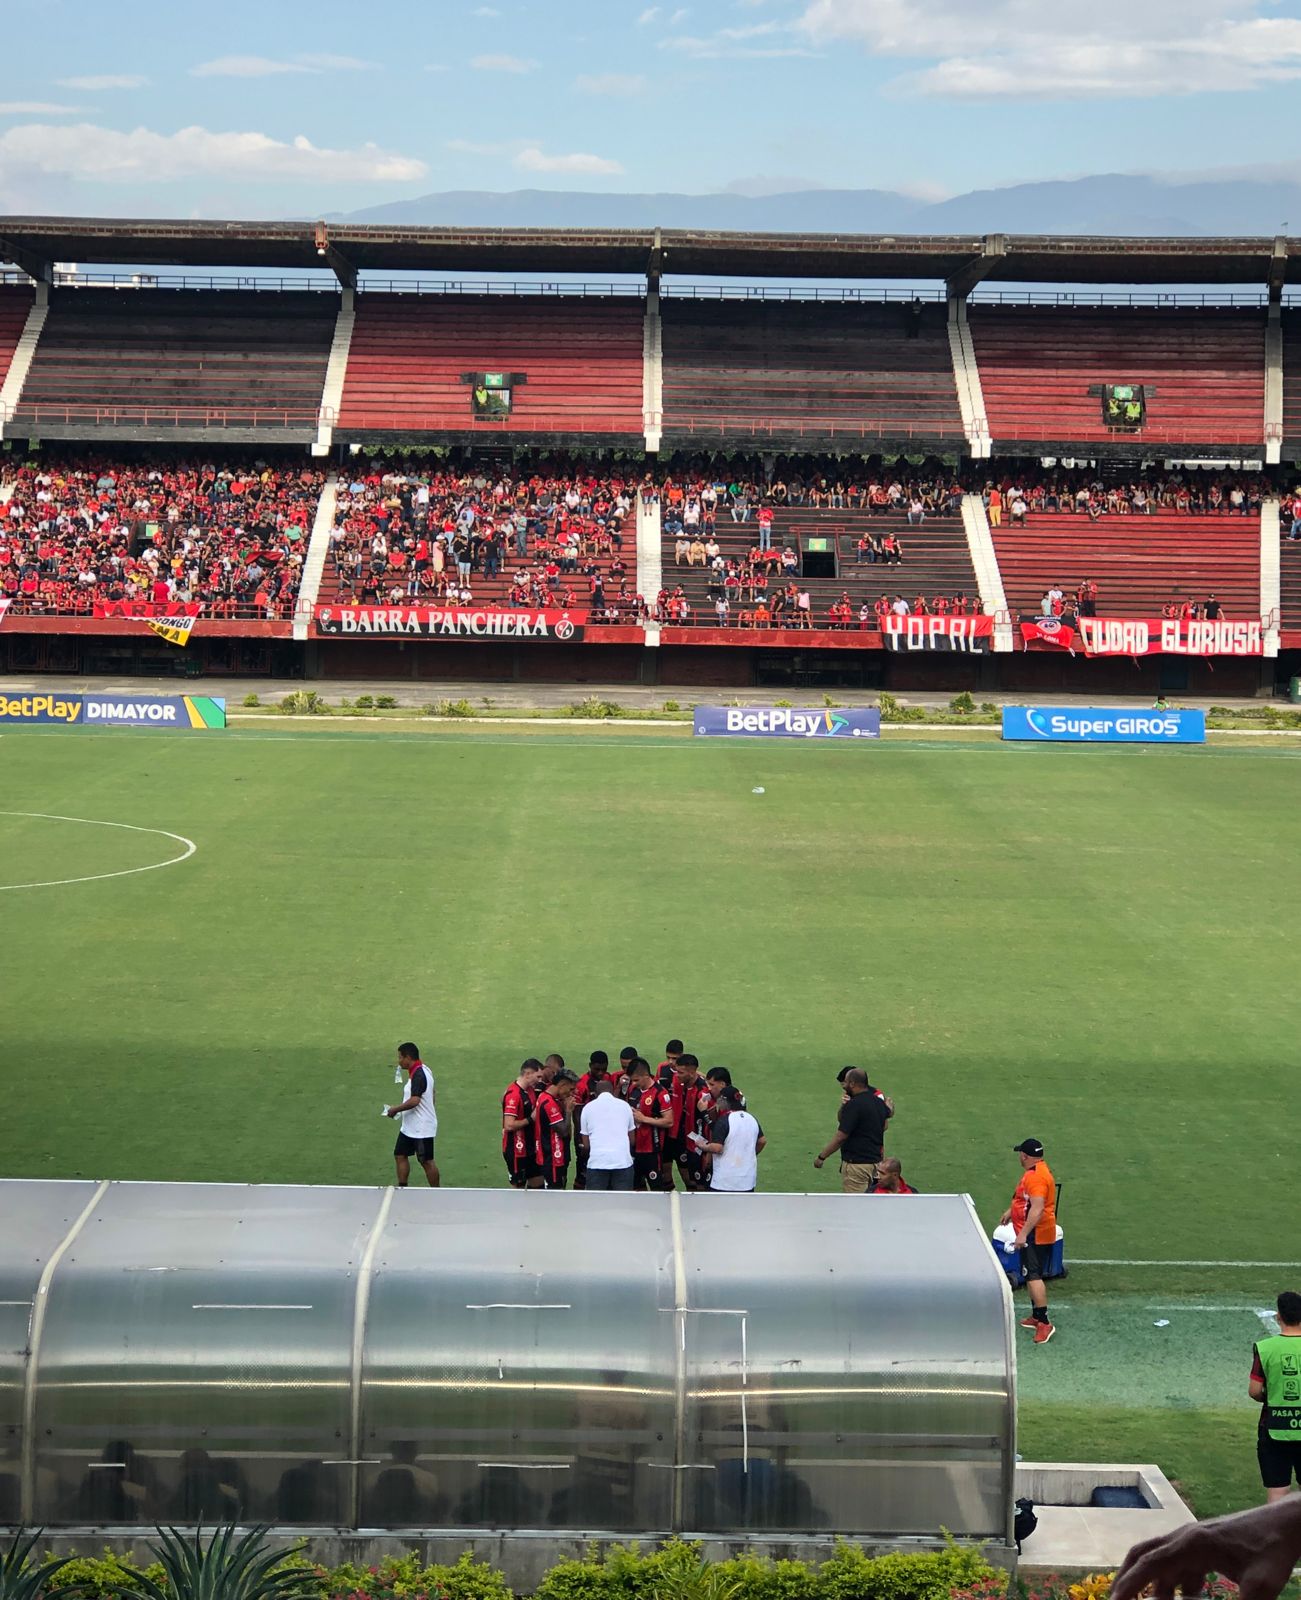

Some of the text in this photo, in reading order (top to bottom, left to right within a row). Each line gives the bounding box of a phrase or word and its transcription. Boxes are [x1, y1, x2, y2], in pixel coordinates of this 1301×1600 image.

[340, 609, 549, 636] BARRA PANCHERA
[886, 616, 983, 654] YOPAL
[1080, 618, 1261, 654] CIUDAD GLORIOSA
[87, 702, 176, 721] DIMAYOR
[726, 709, 822, 737] BetPlay
[1271, 1409, 1294, 1417] PASA
